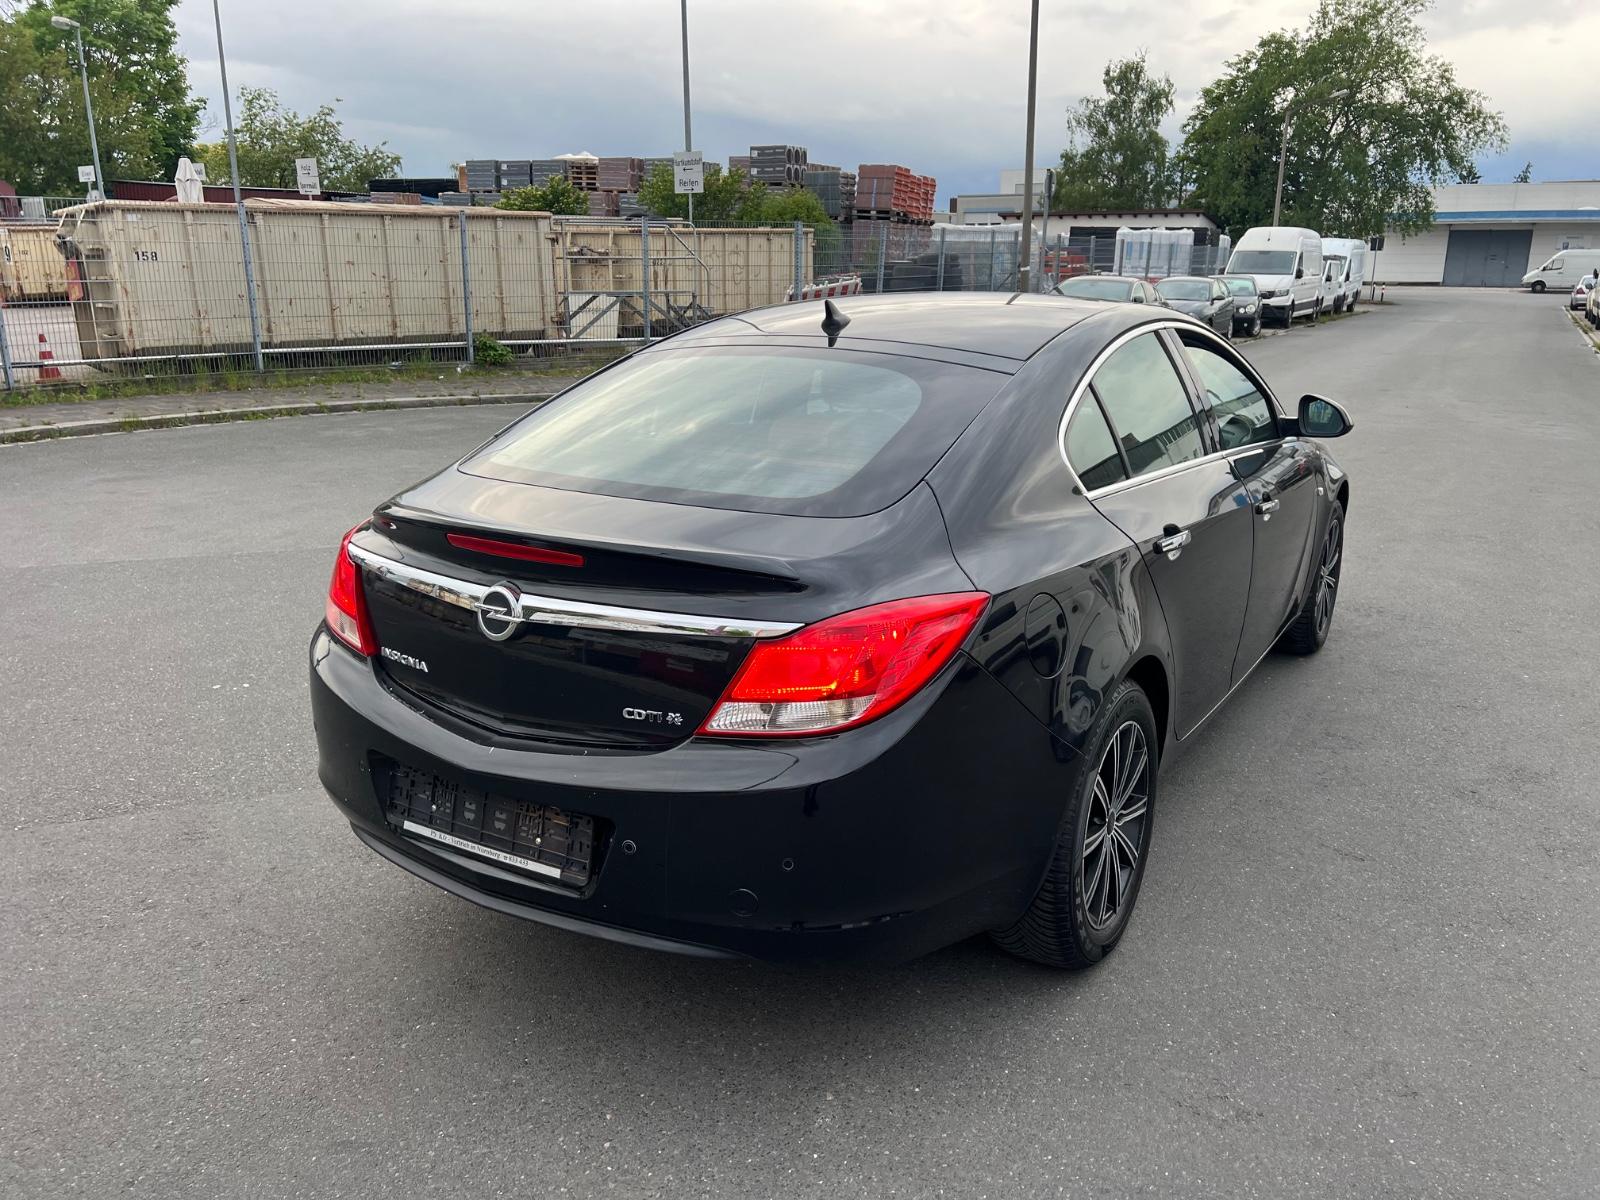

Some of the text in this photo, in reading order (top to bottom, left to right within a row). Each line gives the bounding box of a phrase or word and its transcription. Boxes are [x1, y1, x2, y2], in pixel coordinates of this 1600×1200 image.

[679, 178, 699, 187] Reifen
[134, 251, 158, 261] 158
[381, 646, 429, 673] INSIGNIA
[622, 707, 663, 722] CDTI
